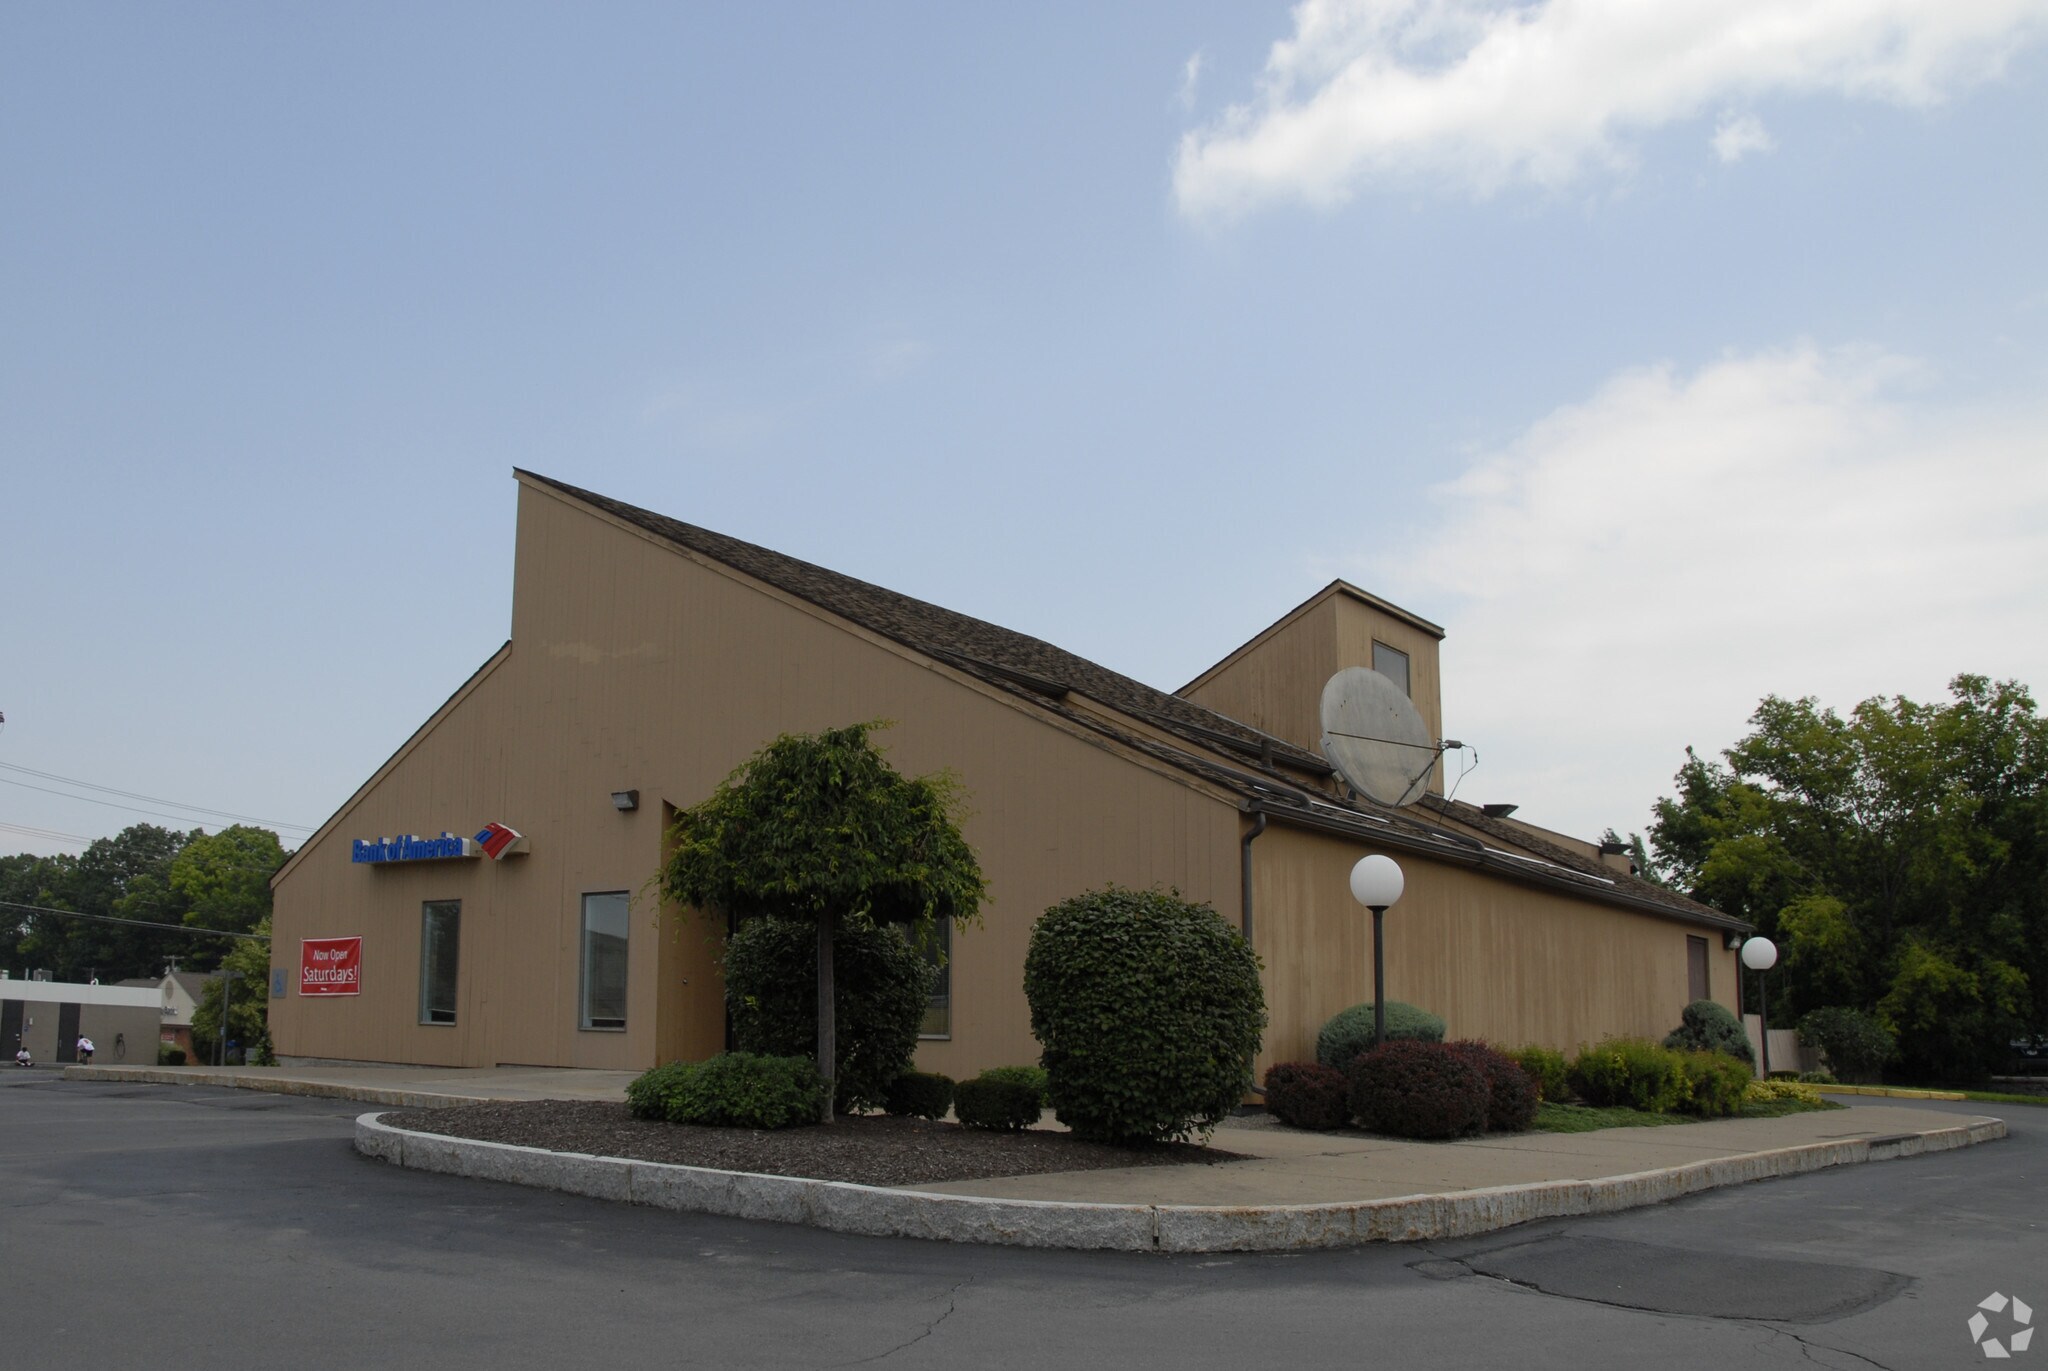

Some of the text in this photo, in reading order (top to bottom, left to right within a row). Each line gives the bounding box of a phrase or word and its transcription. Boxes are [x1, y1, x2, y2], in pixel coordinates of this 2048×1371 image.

[352, 832, 463, 863] Bank of America
[313, 948, 348, 962] Now Open
[303, 965, 357, 984] Saturdays!
